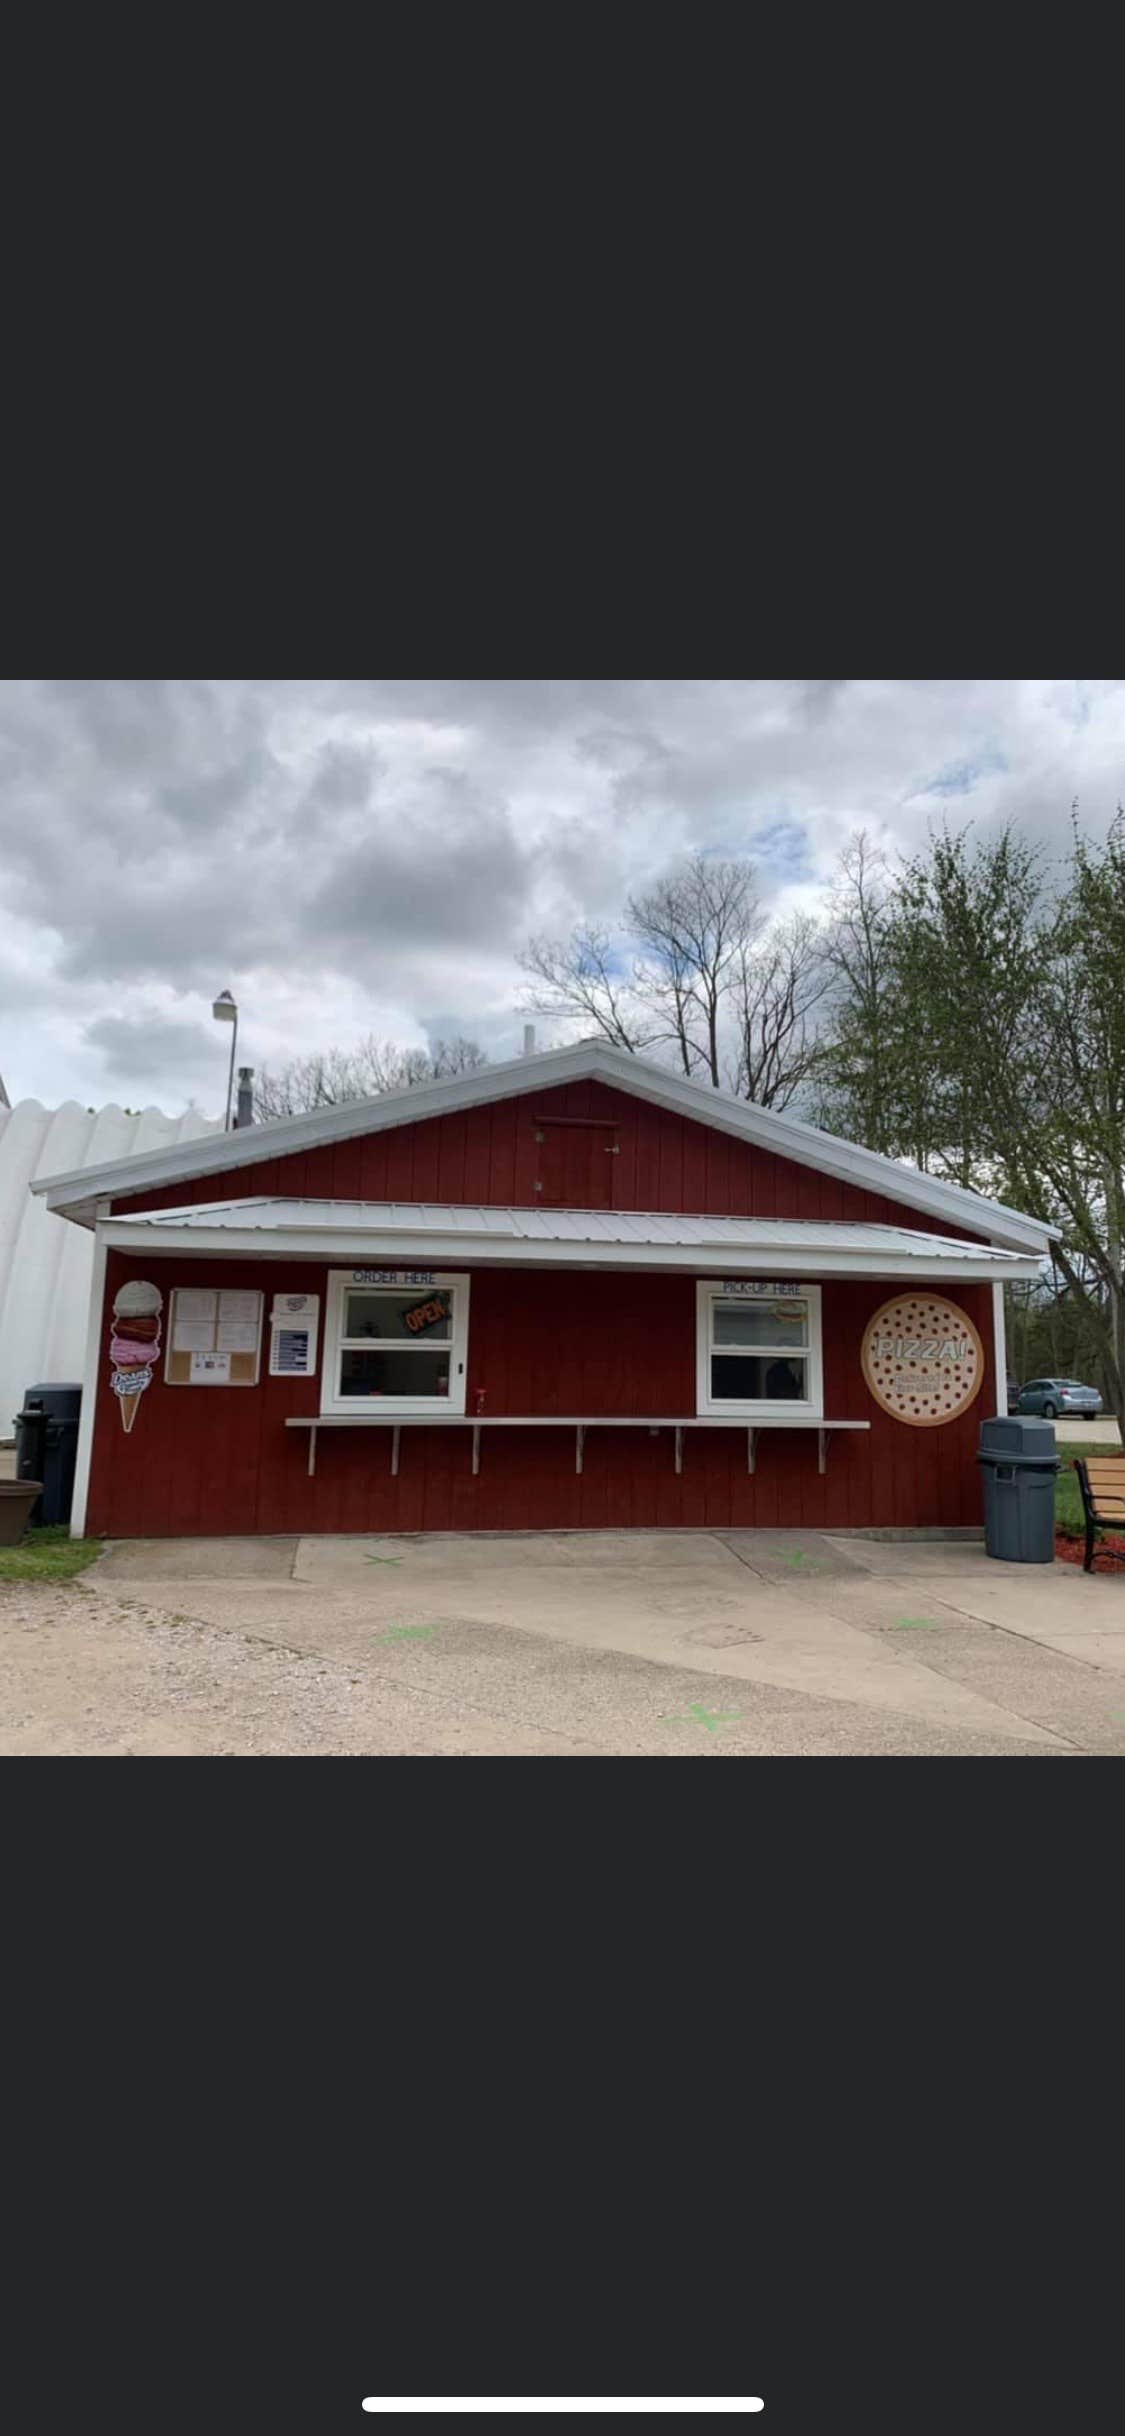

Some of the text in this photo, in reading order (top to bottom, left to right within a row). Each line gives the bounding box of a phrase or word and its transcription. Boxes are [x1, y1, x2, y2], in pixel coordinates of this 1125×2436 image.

[352, 1271, 436, 1285] ORDER HERE
[723, 1281, 801, 1296] PICK-UP HERE
[406, 1301, 446, 1330] OPEN
[875, 1337, 967, 1360] PIZZA!
